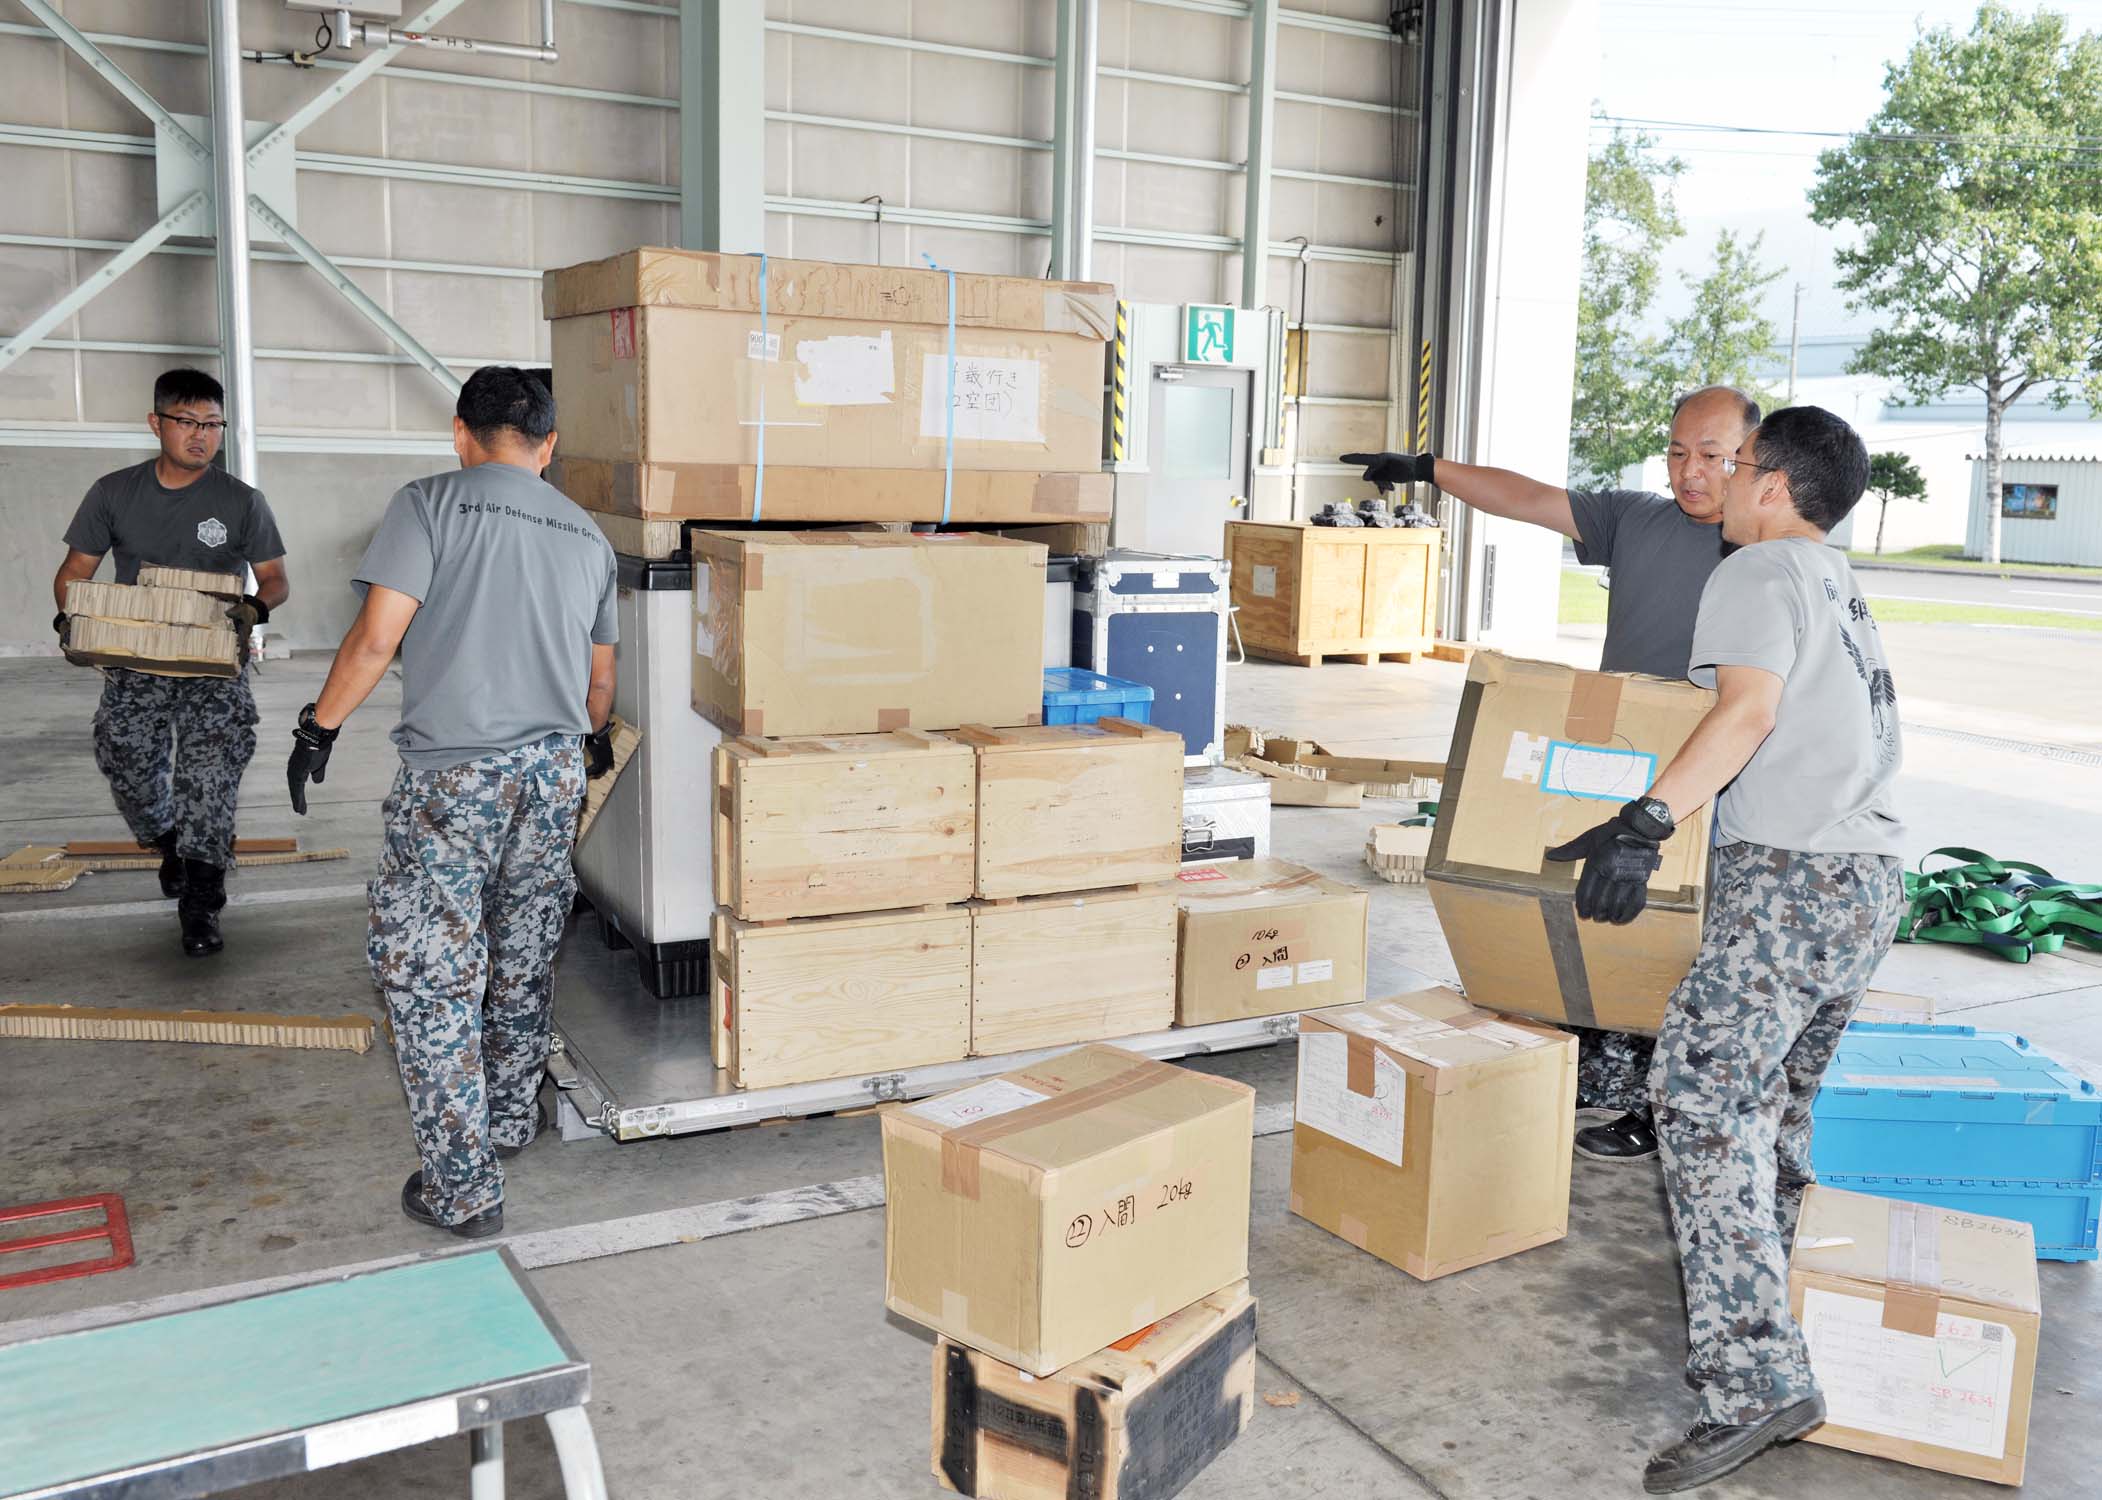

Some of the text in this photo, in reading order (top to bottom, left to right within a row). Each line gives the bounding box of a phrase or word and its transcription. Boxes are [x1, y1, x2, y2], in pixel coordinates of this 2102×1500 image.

[459, 503, 481, 515] 3rd
[485, 503, 502, 514] Air
[505, 505, 543, 525] Defense
[546, 517, 579, 535] Missile
[1098, 1195, 1134, 1237] 入間
[1156, 1177, 1192, 1209] 20kg
